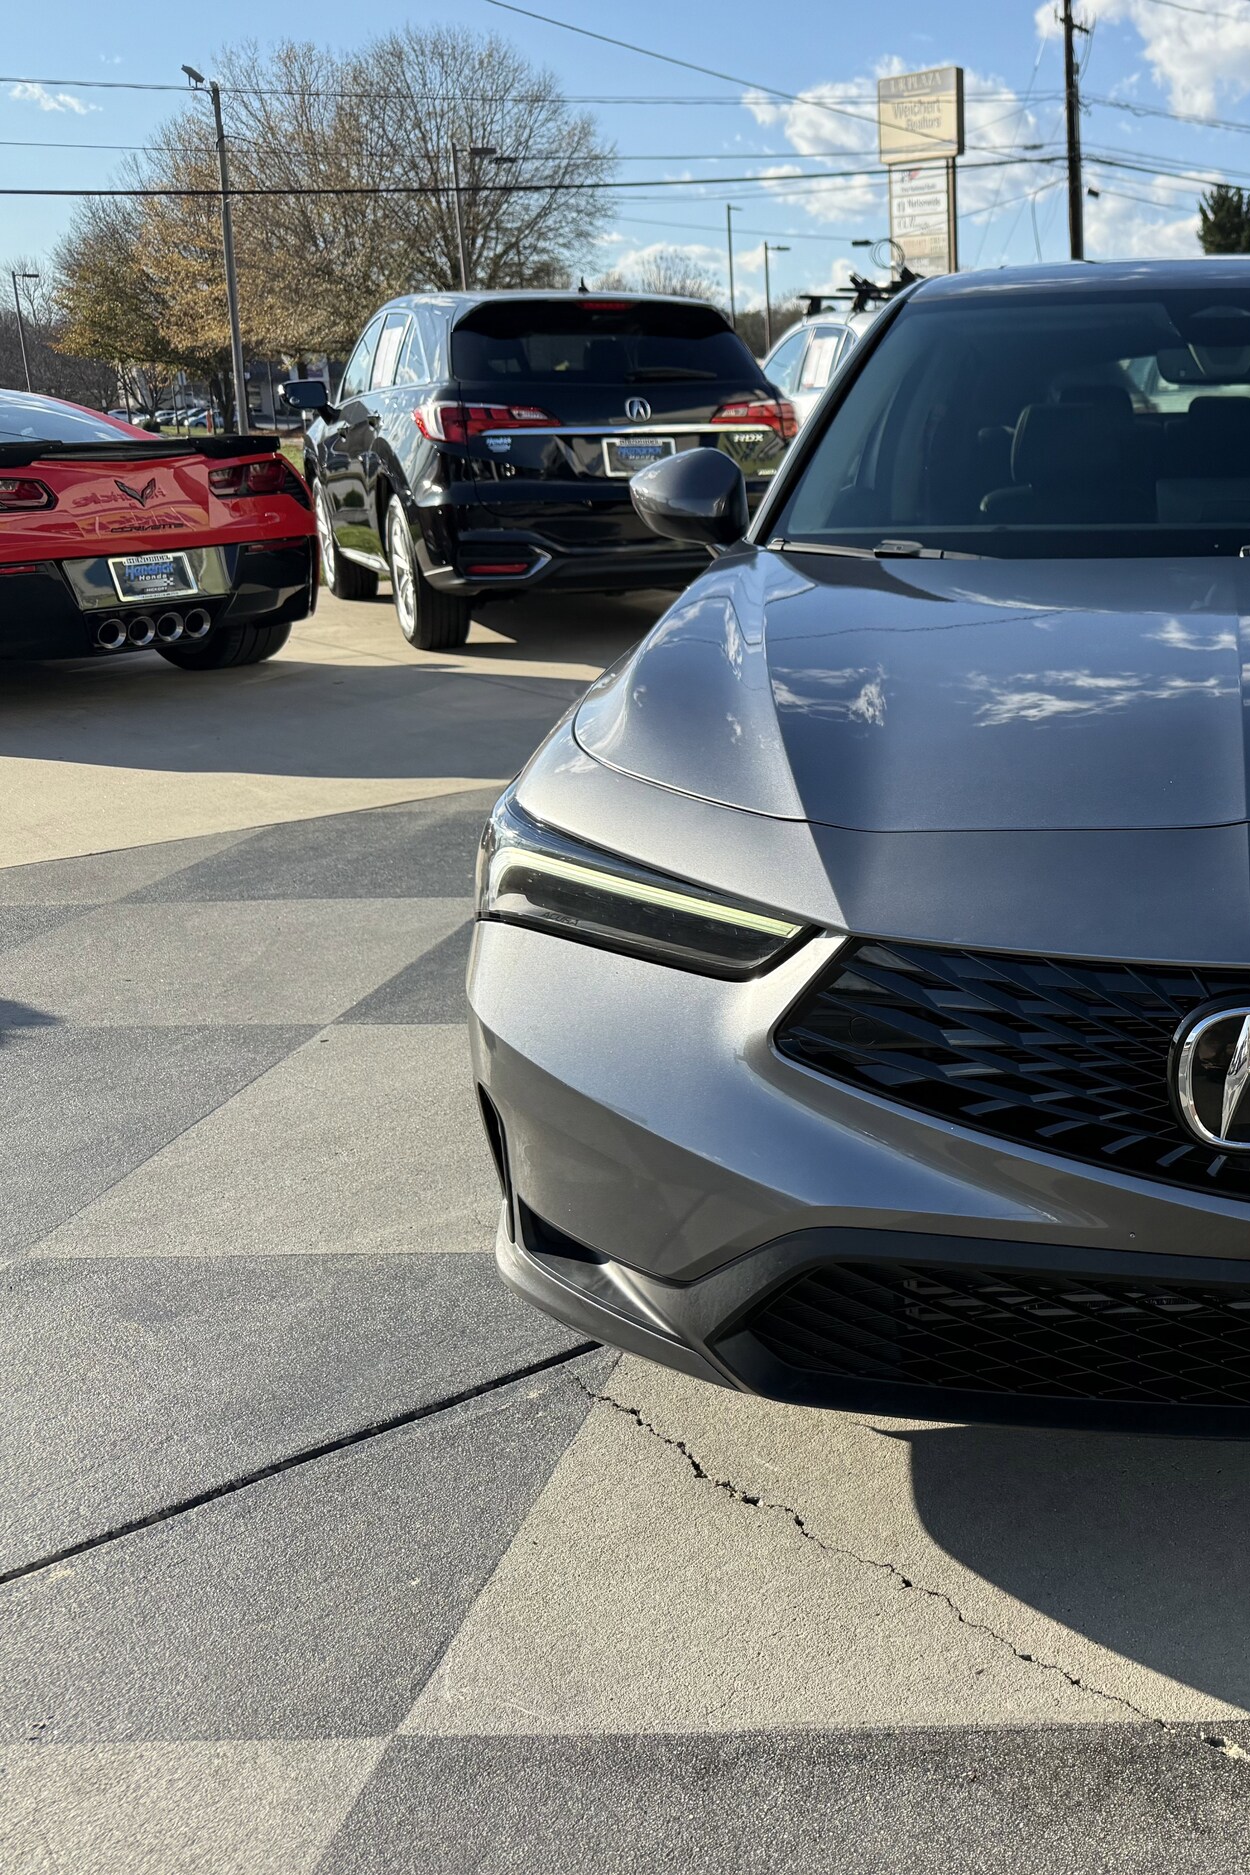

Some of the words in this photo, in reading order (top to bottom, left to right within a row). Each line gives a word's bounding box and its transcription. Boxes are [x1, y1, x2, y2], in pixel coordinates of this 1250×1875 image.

[111, 523, 184, 533] CORVETTE
[125, 562, 174, 582] Hendrick
[139, 573, 167, 581] Honda
